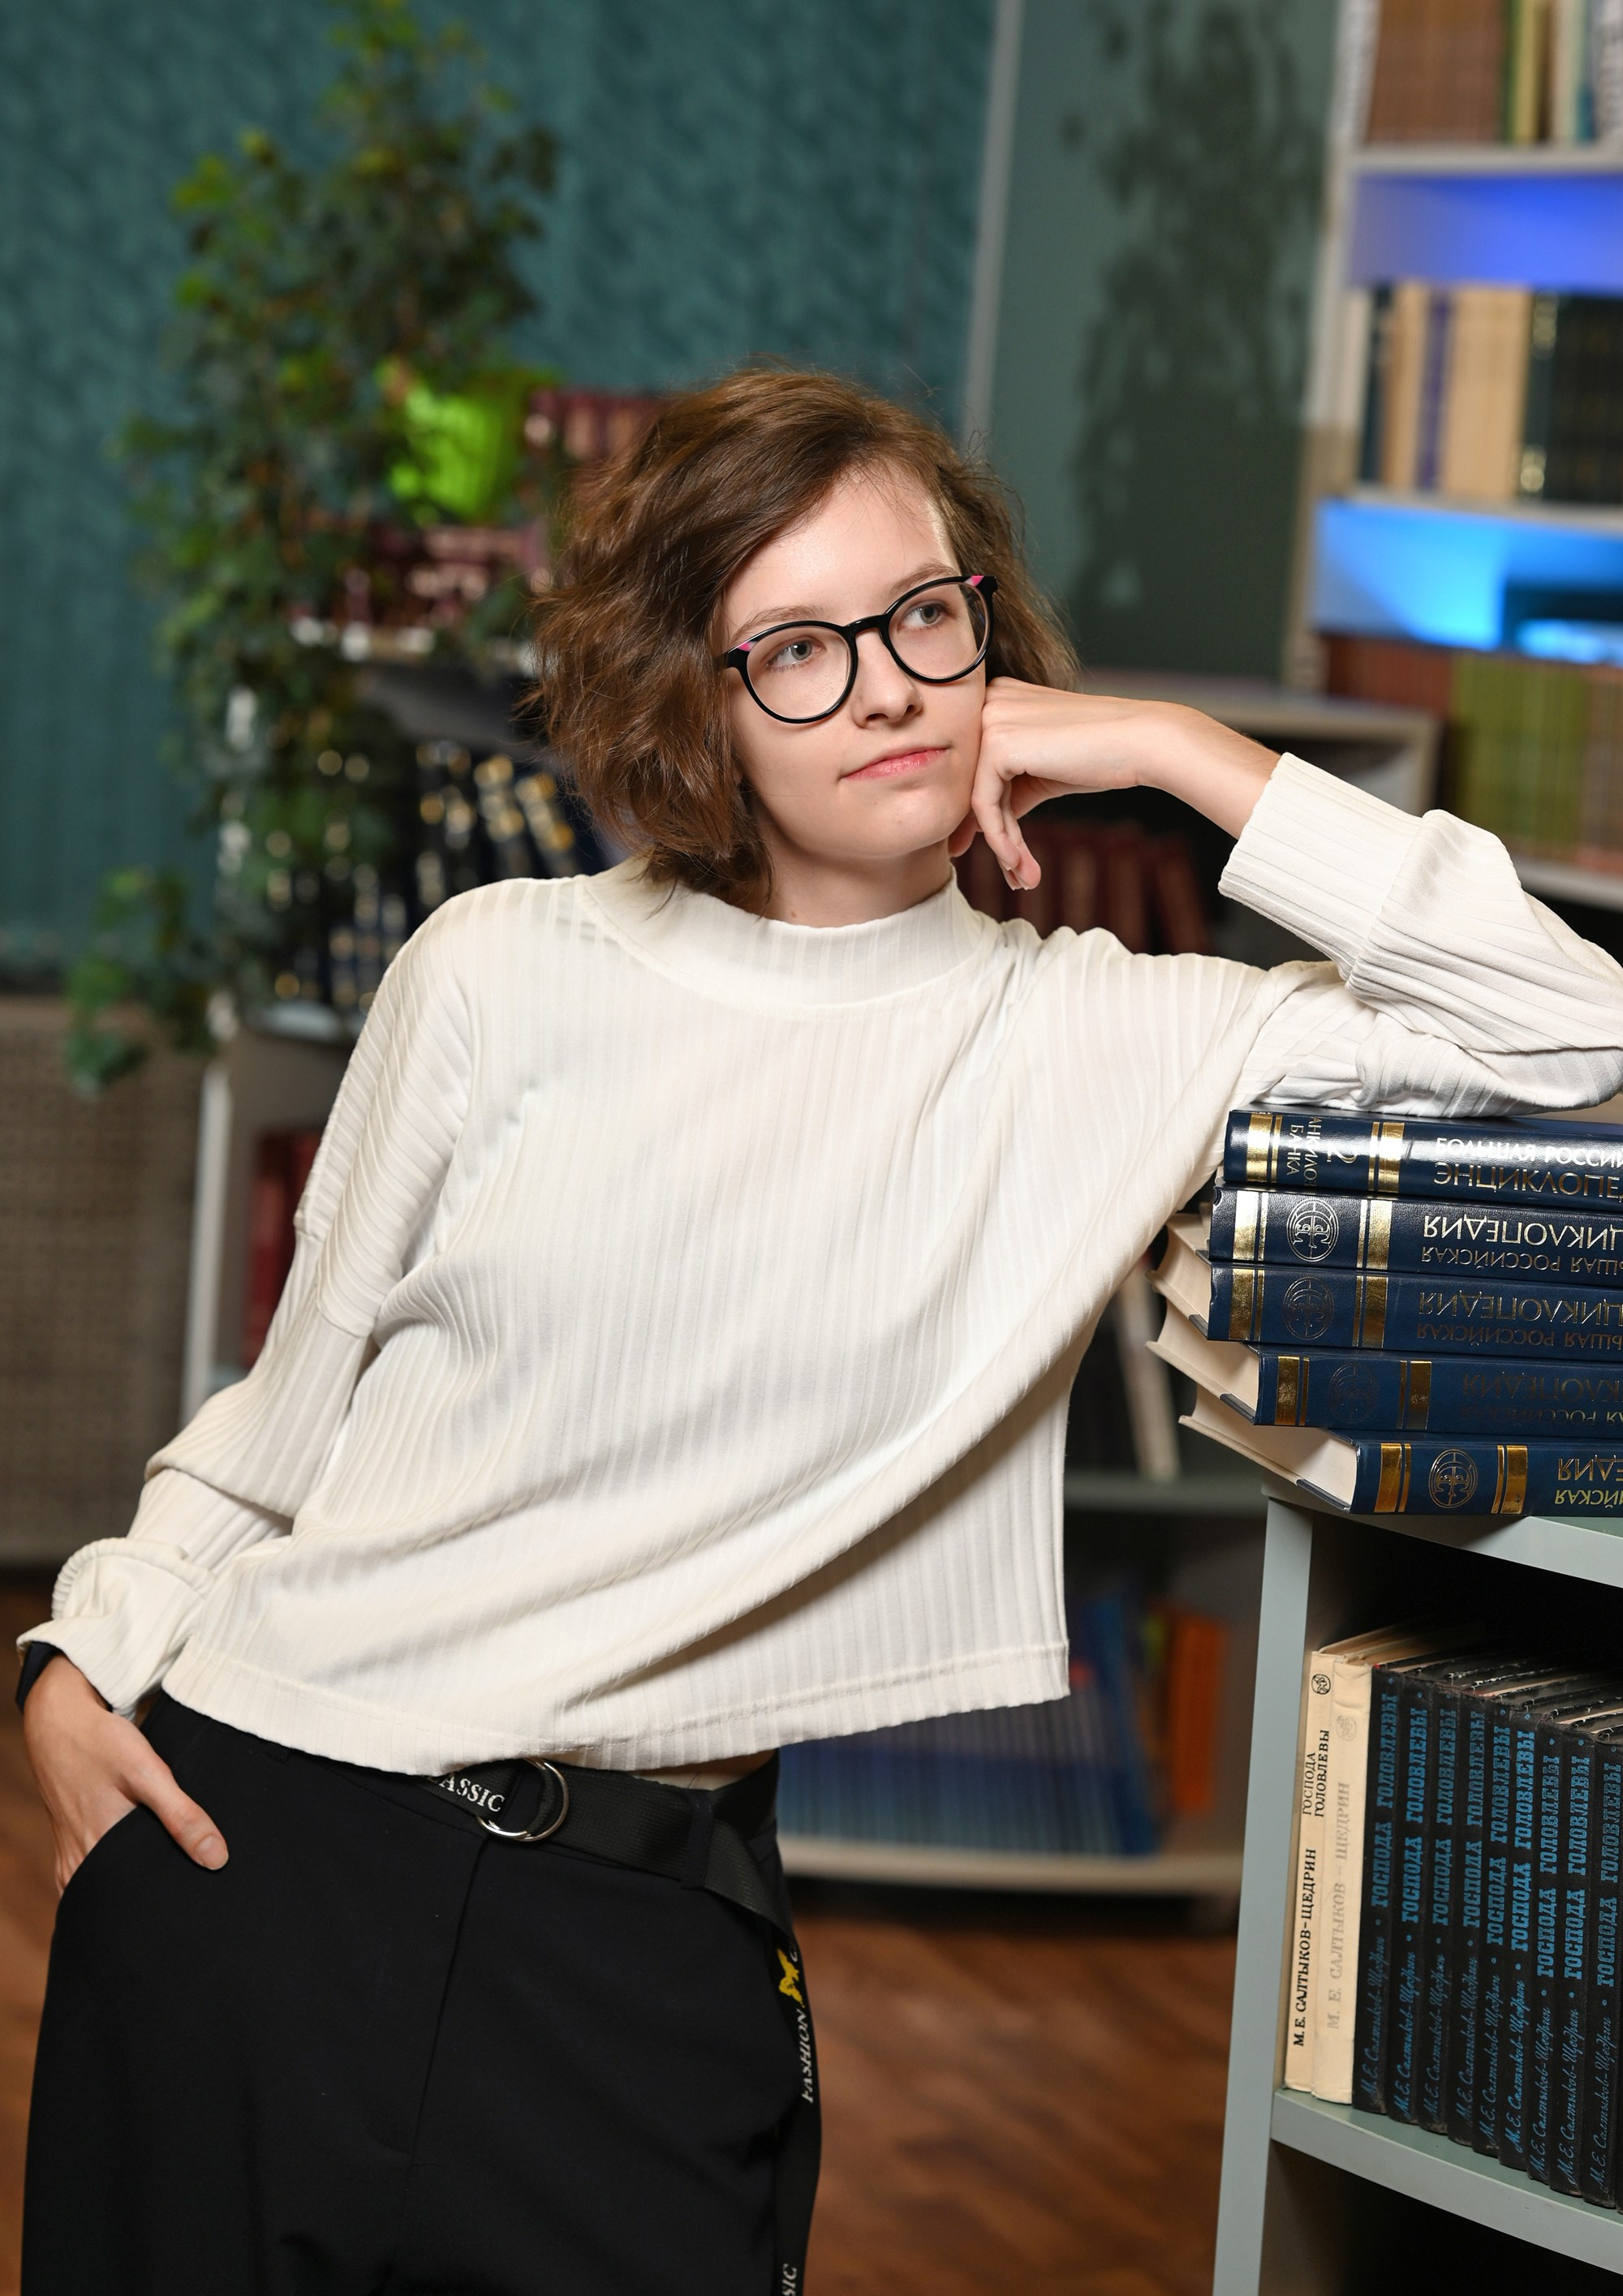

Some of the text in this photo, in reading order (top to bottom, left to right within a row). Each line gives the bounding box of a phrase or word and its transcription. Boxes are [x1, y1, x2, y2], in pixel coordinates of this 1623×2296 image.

[1286, 1124, 1305, 1176] БАНКА
[1433, 1162, 1623, 1203] ЭНЦИКЛОПЕ
[1436, 1137, 1536, 1162] БОЛЬШАЯ
[1421, 1246, 1561, 1271] РОССИЙСКАЯ
[1415, 1322, 1556, 1347] РОССИЙСКАЯ
[1462, 1370, 1623, 1404] КЛОПЕДИЯ
[1301, 1752, 1317, 1816] ГОСПОДА
[1314, 1729, 1330, 1818] ГОЛОВЛЕВЫ
[1376, 1693, 1397, 1808] ГОЛОВЛЕВЫ
[1406, 1707, 1427, 1824] ГОЛОВЛЕВЫ
[1436, 1709, 1457, 1825] ГОЛОВЛЕВЫ
[1491, 1726, 1509, 1843] ГОЛОВЛЕВЫ
[1513, 1731, 1535, 1850] ГОЛОВЛЕВЫ
[1335, 1782, 1350, 1860] ЩЕДРИН
[1539, 1755, 1560, 1874] ГОЛОВЛЕВЫ
[1568, 1755, 1591, 1876] ГОЛОВЛЕВЫ
[1600, 1762, 1621, 1883] ГОЛОВЛЕВЫ
[1371, 1821, 1392, 1908] ГОСПОДА
[1401, 1836, 1423, 1923] ГОСПОДА
[1432, 1838, 1453, 1926] ГОСПОДА
[1463, 1841, 1483, 1928] ГОСПОДА
[1487, 1857, 1507, 1946] ГОСПОДА
[1511, 1863, 1532, 1951] ГОСПОДА
[1295, 1848, 1317, 2013] САЛТЫКОВ-ЩЕДРИН
[1329, 1882, 1346, 1980] САЛТЫКОВ
[1536, 1888, 1557, 1977] ГОСПОДА
[1564, 1889, 1586, 1980] ГОСПОДА
[1596, 1897, 1618, 1988] ГОСПОДА
[796, 2009, 814, 2104] FASHION
